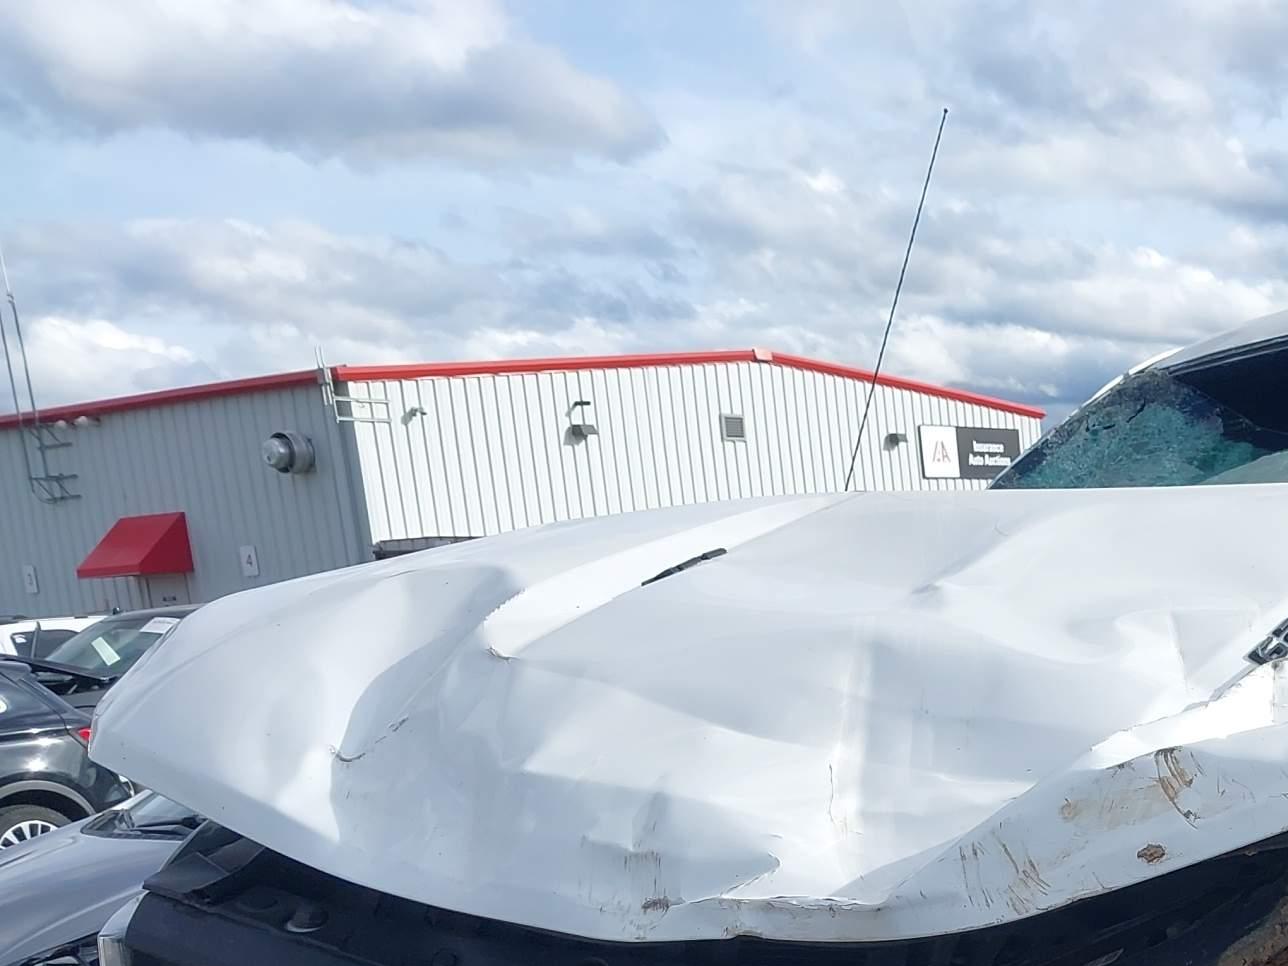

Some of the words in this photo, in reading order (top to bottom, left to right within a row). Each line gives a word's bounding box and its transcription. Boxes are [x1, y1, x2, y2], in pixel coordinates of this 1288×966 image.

[972, 440, 1005, 453] Insurance
[969, 453, 984, 466] Auto
[246, 553, 253, 567] 4
